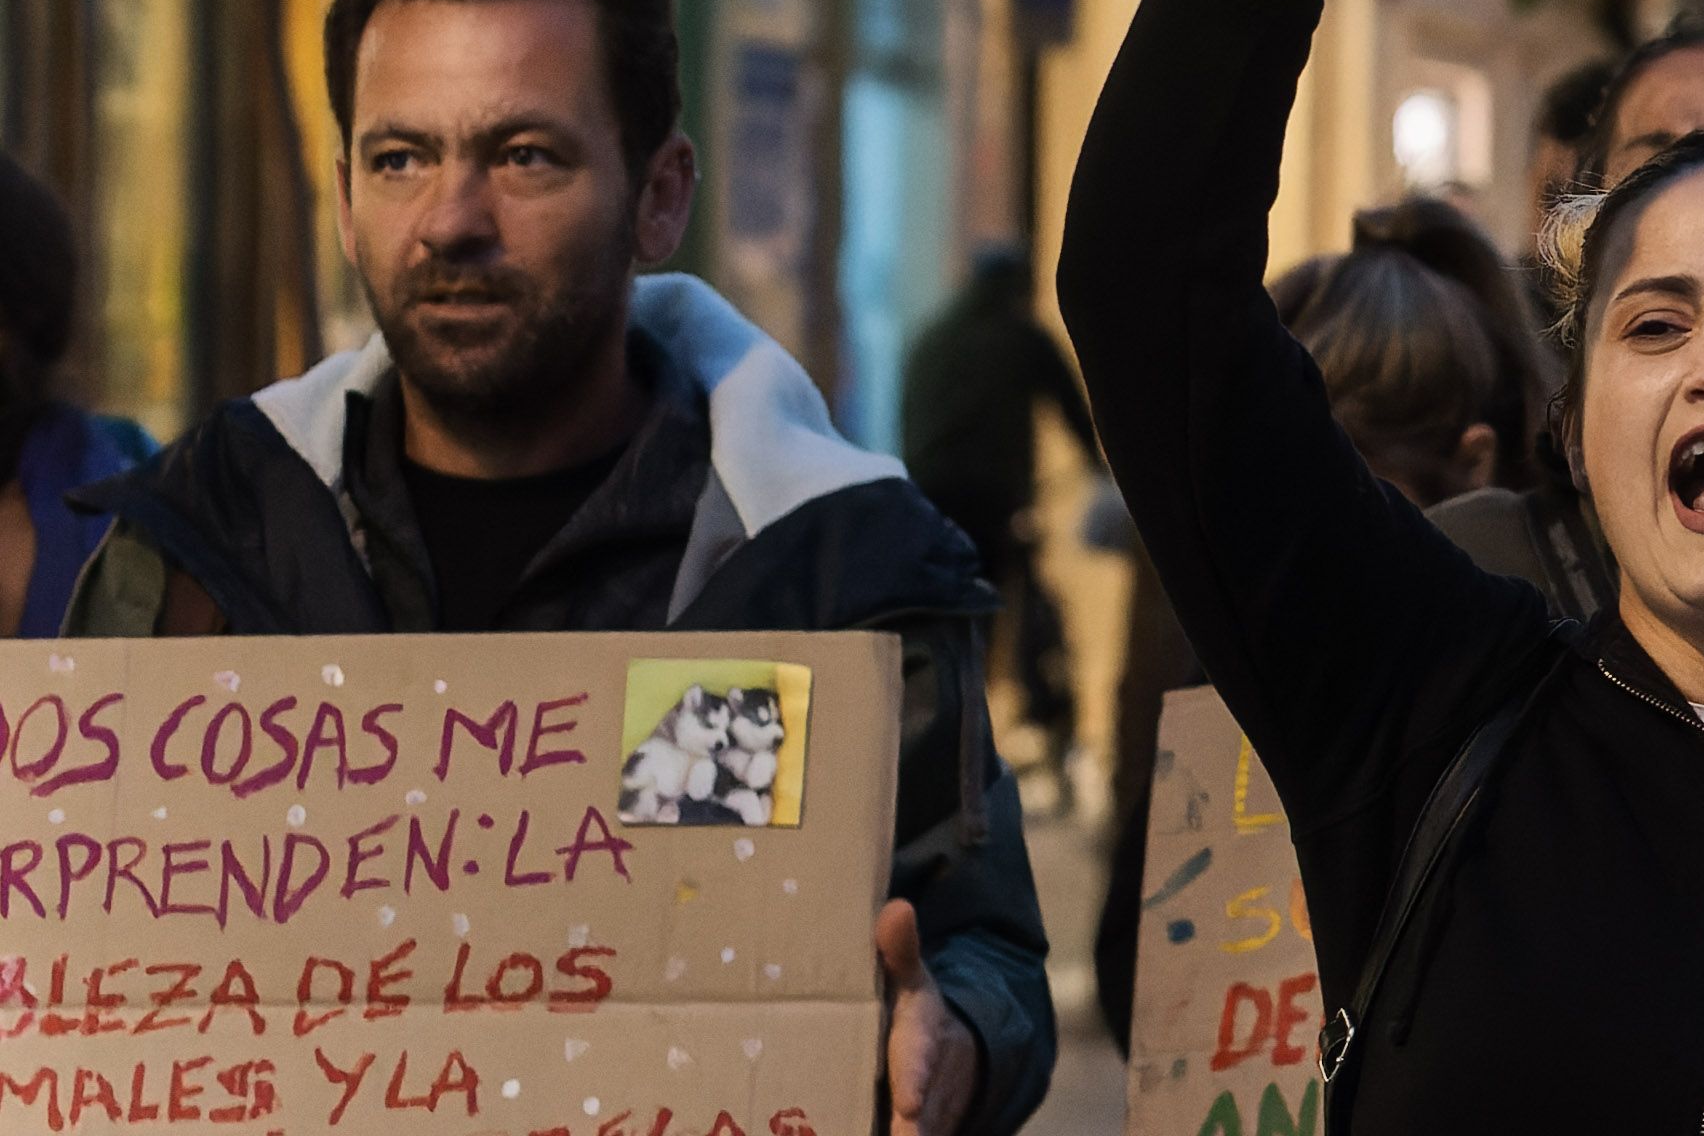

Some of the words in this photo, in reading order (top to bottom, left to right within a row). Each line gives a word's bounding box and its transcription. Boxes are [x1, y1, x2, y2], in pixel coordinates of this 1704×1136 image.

[0, 692, 125, 798] OS
[150, 694, 404, 799] COSAS
[432, 691, 589, 782] ME
[293, 937, 417, 1037] DE
[442, 941, 617, 1014] LOS
[0, 1055, 283, 1132] MALES
